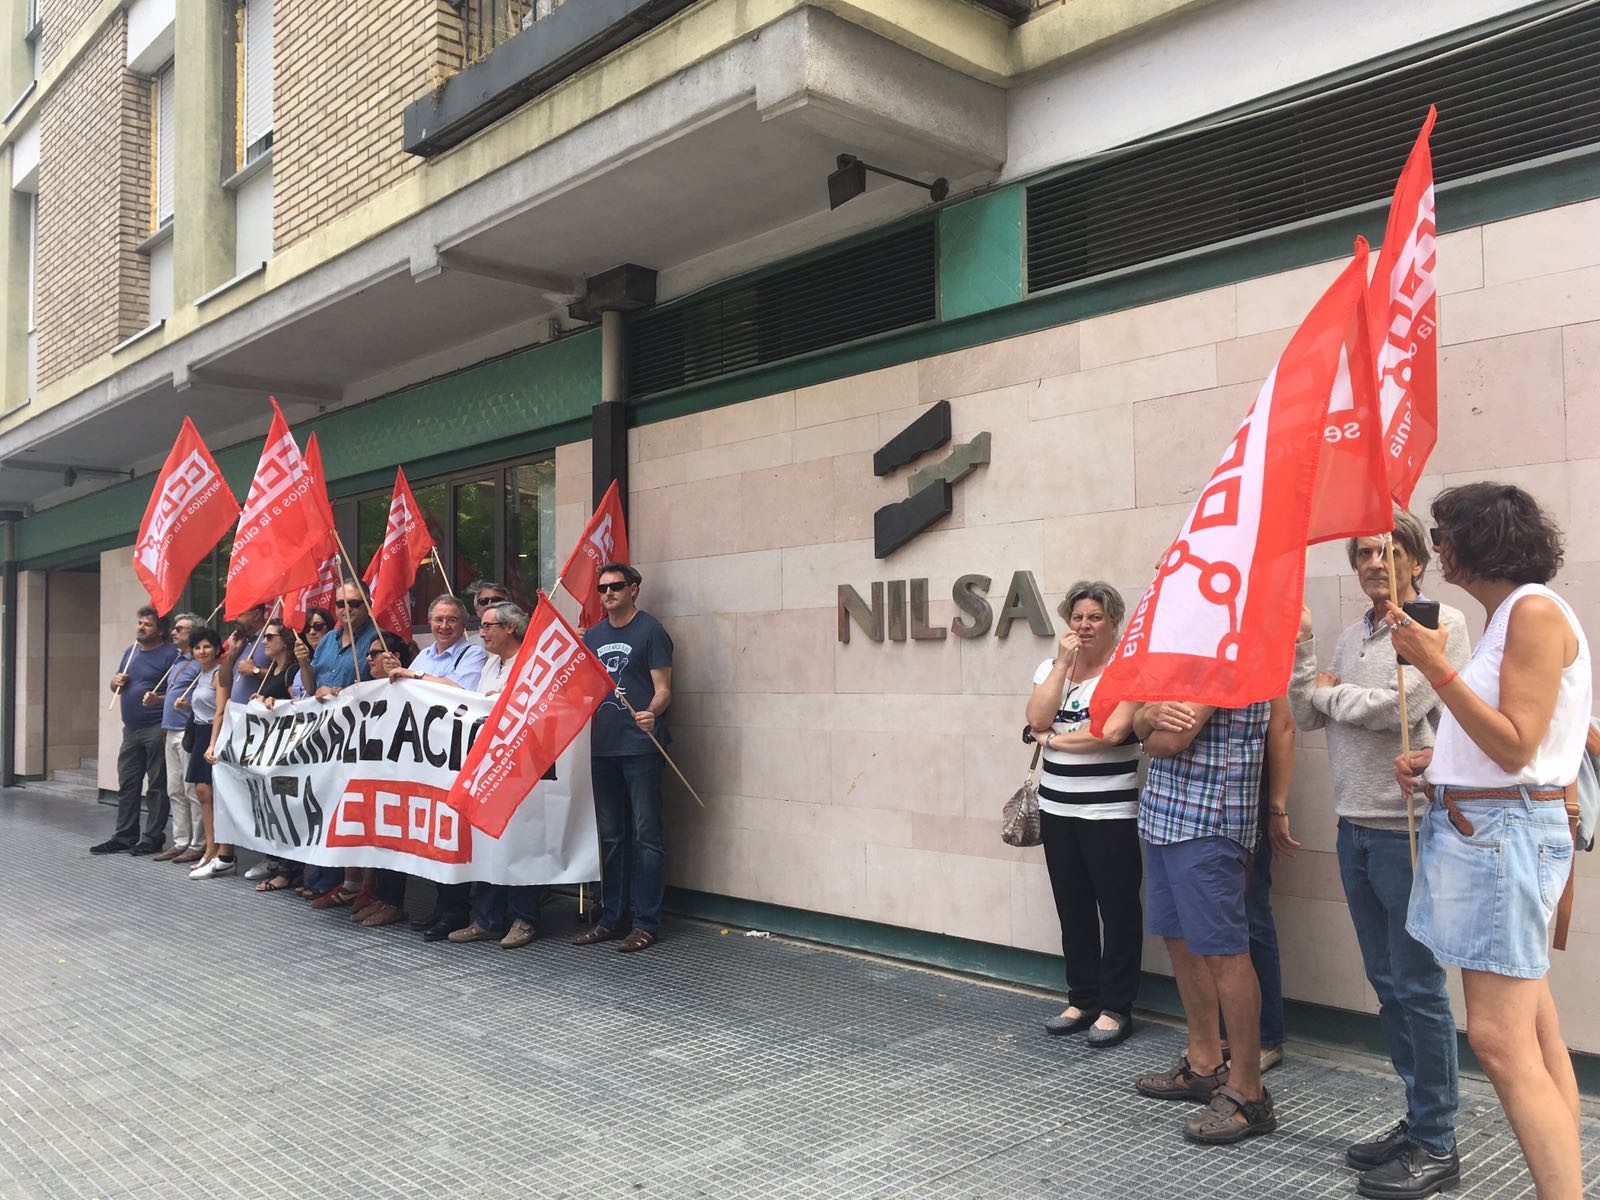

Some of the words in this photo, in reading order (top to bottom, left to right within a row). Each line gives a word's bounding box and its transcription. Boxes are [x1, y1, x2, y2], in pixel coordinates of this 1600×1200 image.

[838, 570, 1055, 643] NILSA
[246, 774, 322, 847] MATA
[335, 791, 459, 852] CCOO
